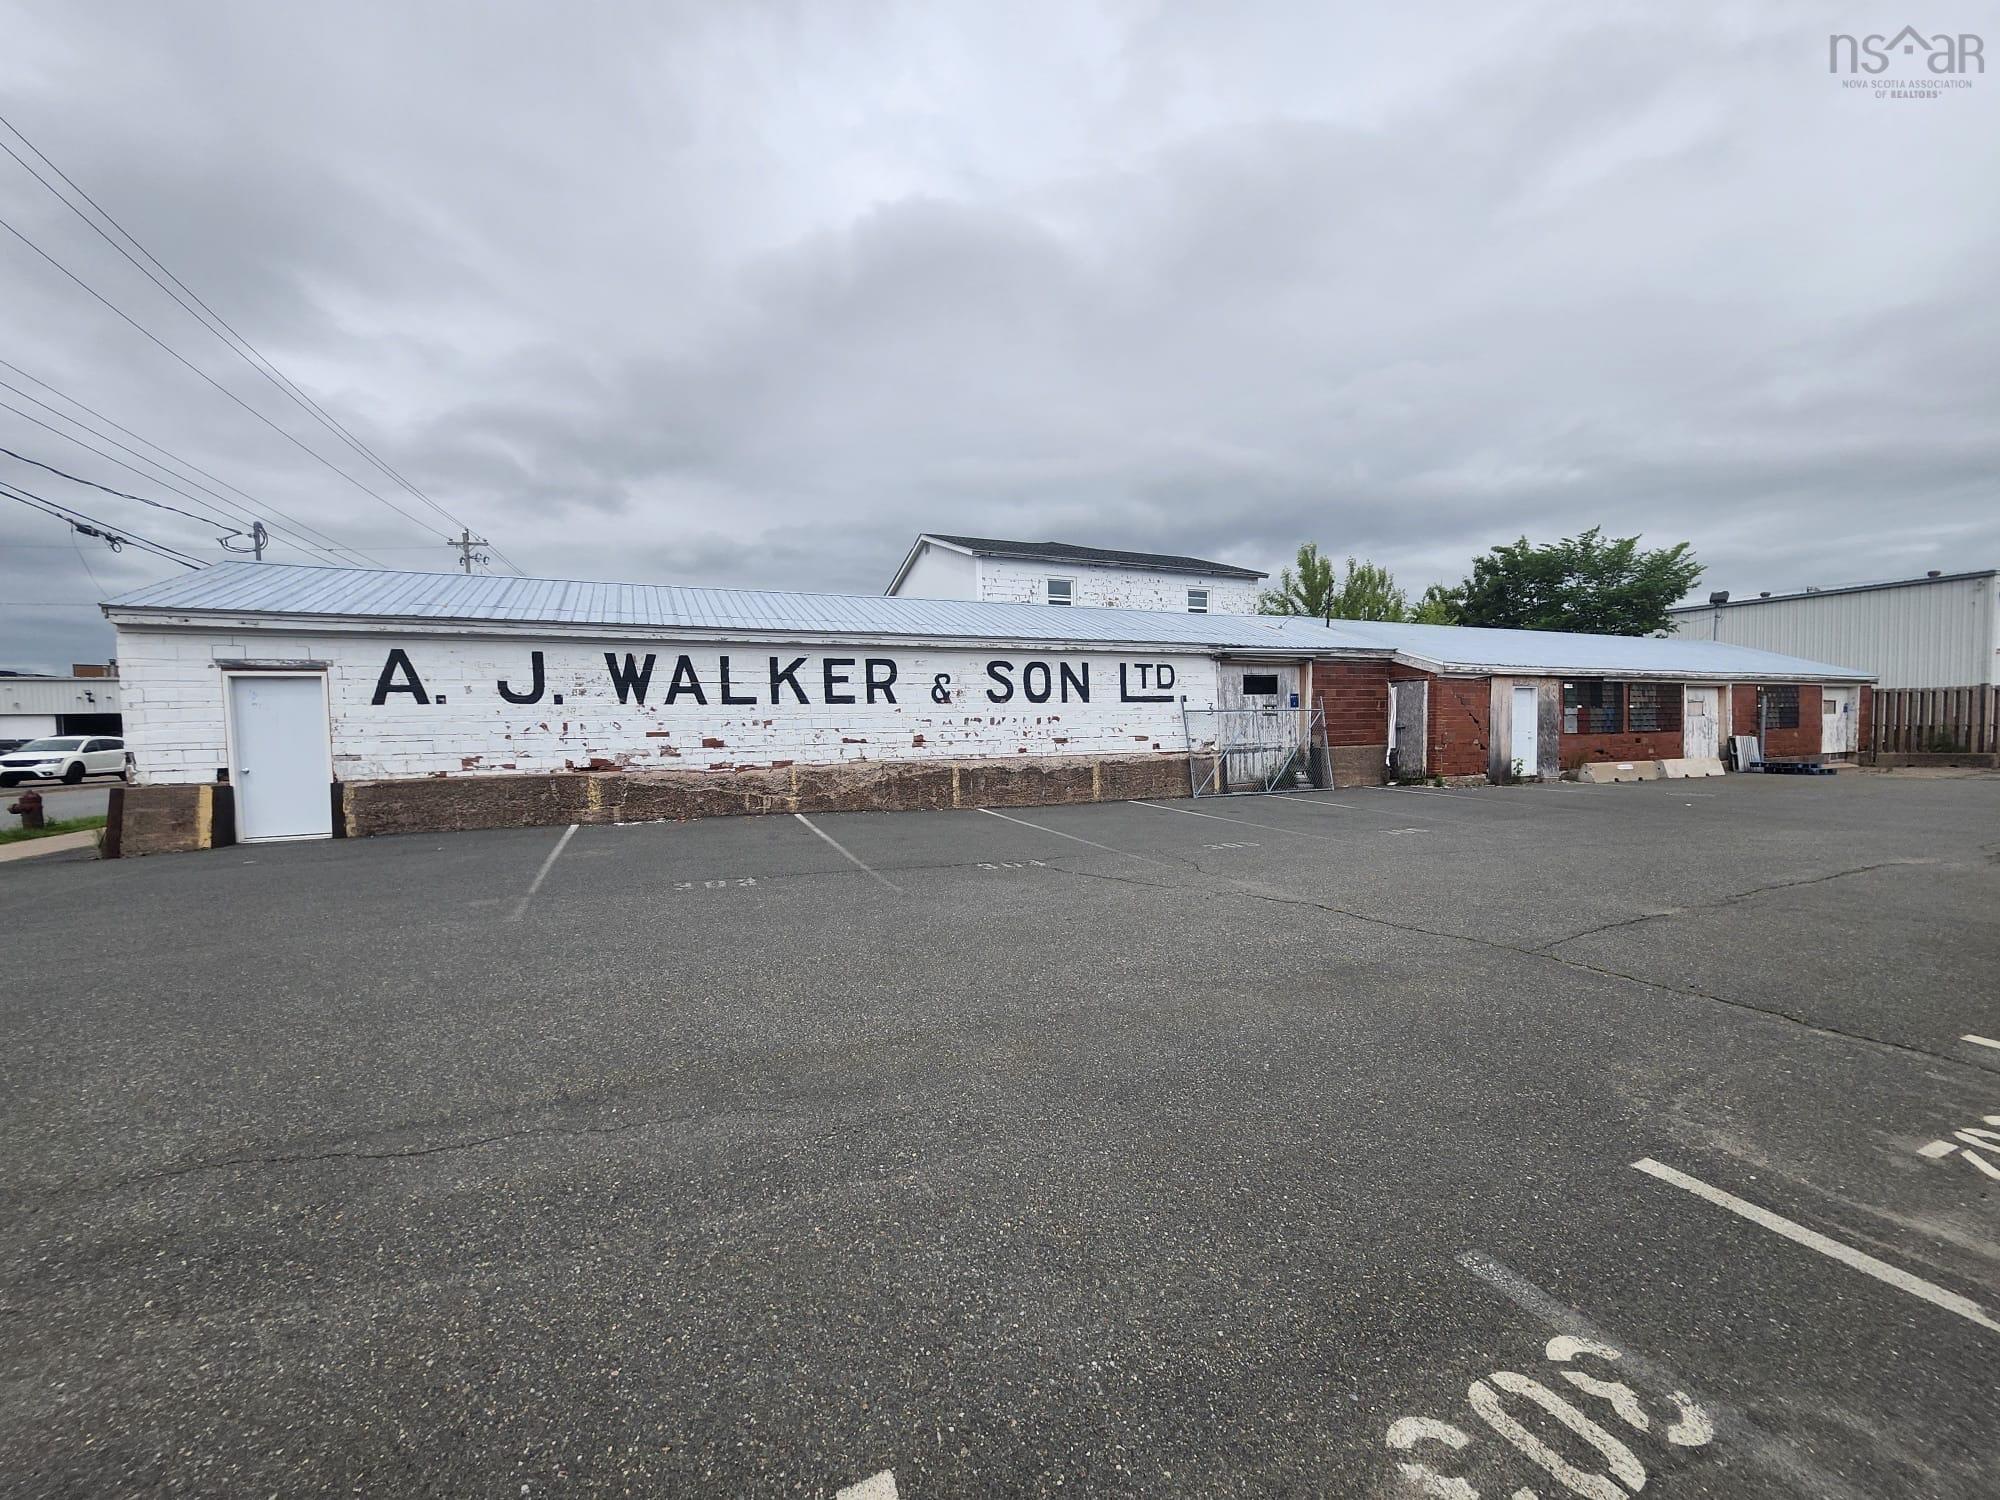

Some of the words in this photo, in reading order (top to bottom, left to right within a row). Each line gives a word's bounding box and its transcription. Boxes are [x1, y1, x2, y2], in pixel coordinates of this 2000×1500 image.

[372, 649, 446, 705] A.
[498, 652, 563, 704] J.
[604, 653, 897, 705] WALKER
[932, 674, 951, 704] &
[987, 661, 1089, 703] SON
[1120, 663, 1174, 702] LTD
